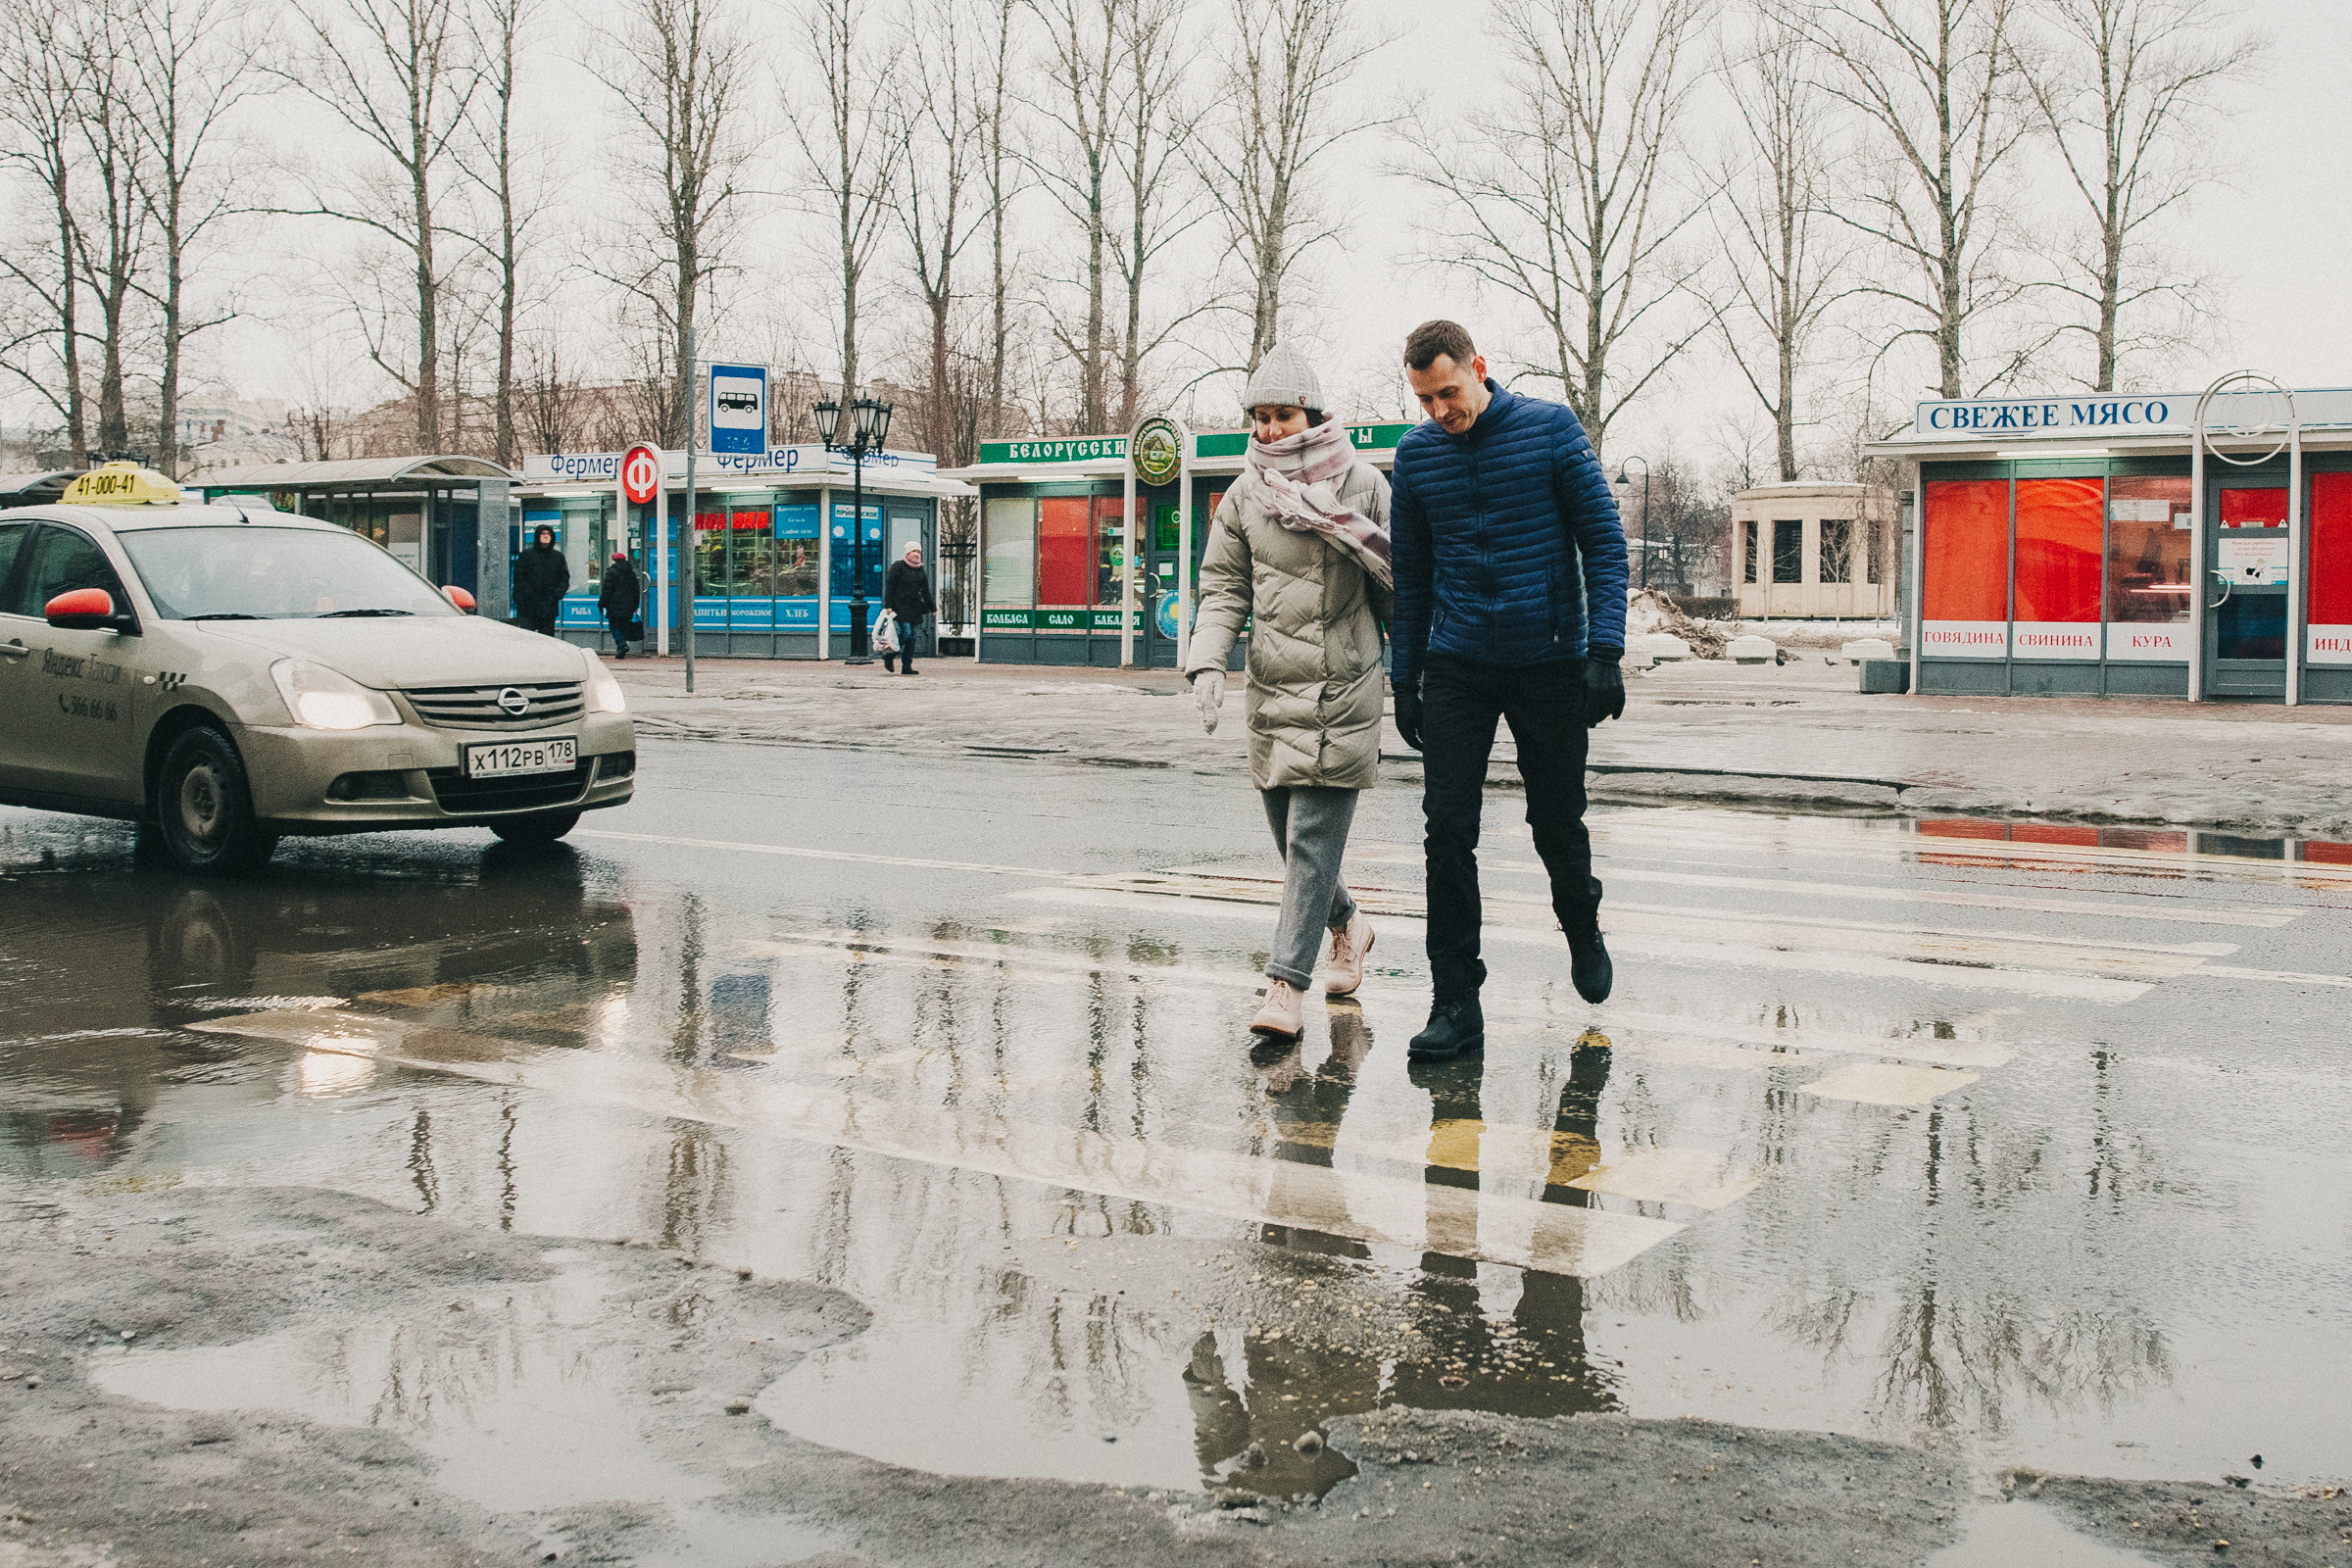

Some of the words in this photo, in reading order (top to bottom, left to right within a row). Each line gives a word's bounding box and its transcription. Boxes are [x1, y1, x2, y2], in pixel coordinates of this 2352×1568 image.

[1930, 404, 2060, 429] СВЕЖЕЕ
[2069, 401, 2169, 426] МЯСО
[842, 447, 900, 467] Фрмер
[1008, 440, 1126, 461] БЕЛОРУССКИ
[627, 452, 658, 498] Ф
[77, 474, 136, 496] 41-000-41
[570, 607, 592, 615] РЫБА
[693, 608, 727, 616] АПИТКИ
[785, 609, 809, 618] ХЛЕБ
[986, 613, 1029, 624] КОЛБАСА
[1048, 613, 1074, 624] САЛО
[1094, 614, 1141, 626] БАКАЯ
[1924, 631, 2004, 645] ГОВЯДИНА
[2019, 634, 2093, 647] СВИНИНА
[2132, 635, 2172, 648] КУРА
[2315, 638, 2352, 653] ИНД
[548, 742, 573, 758] 178
